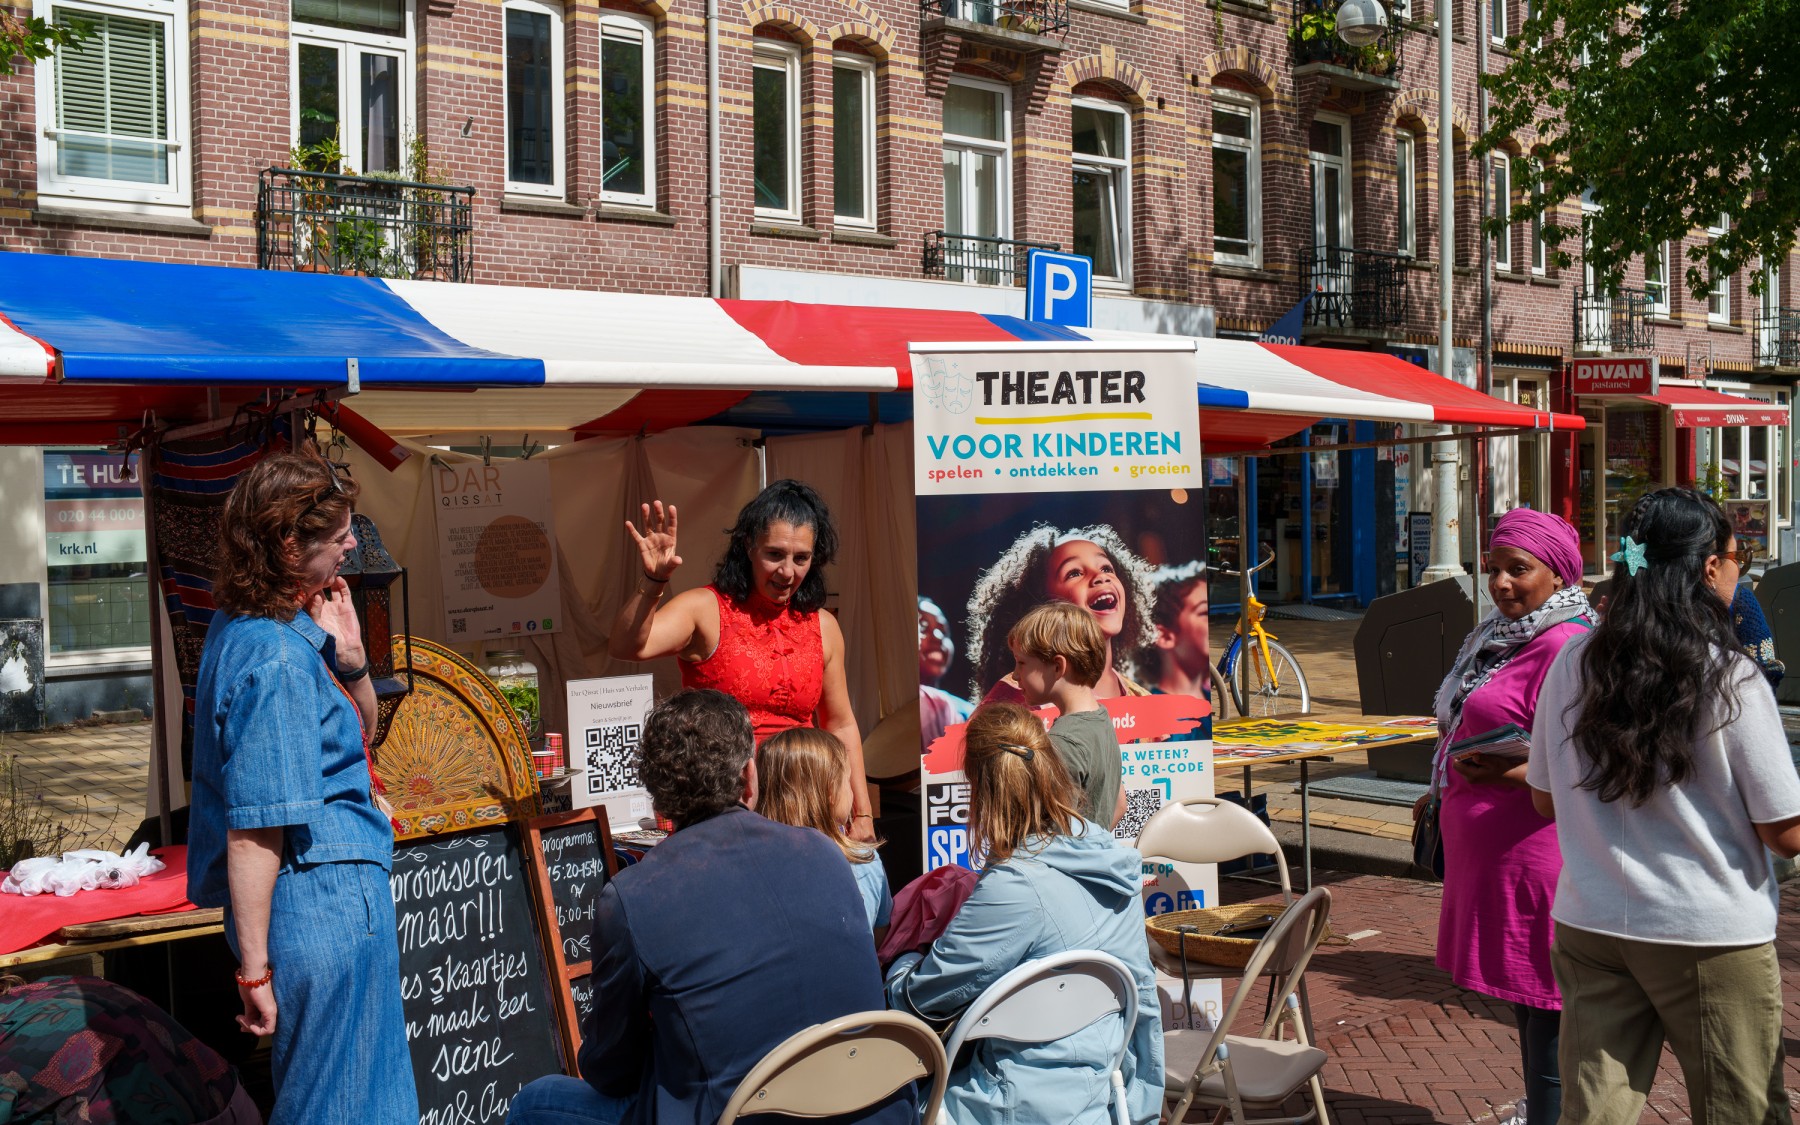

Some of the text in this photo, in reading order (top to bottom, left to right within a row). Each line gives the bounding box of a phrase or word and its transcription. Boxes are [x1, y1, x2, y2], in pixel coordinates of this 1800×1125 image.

[1044, 263, 1077, 320] P
[1259, 332, 1297, 346] HODO
[1577, 364, 1643, 379] DIVAN
[976, 370, 1146, 406] THEATER
[1592, 380, 1630, 391] pastanesi
[1521, 393, 1531, 404] 121
[927, 431, 1181, 460] VOOR KINDEREN
[57, 464, 86, 485] TE
[440, 466, 502, 494] DAR
[928, 462, 1191, 483] spelen ontdekken groeien
[441, 493, 502, 507] QISSAT
[59, 510, 85, 522] 020
[88, 509, 106, 521] 44
[109, 508, 136, 521] 000
[59, 542, 97, 555] krk.nl
[582, 689, 599, 697] Qissat
[590, 699, 633, 710] Nieuwsbrief
[1135, 749, 1189, 761] WETEN?
[1141, 762, 1204, 776] QR-CODE
[929, 784, 971, 805] JE
[390, 852, 513, 903] proviseren
[1158, 863, 1173, 878] op
[398, 889, 504, 953] maar!!!
[427, 992, 490, 1038] maak
[499, 992, 535, 1020] een
[1172, 1001, 1218, 1021] DAR
[1172, 1020, 1218, 1030] QISSAT
